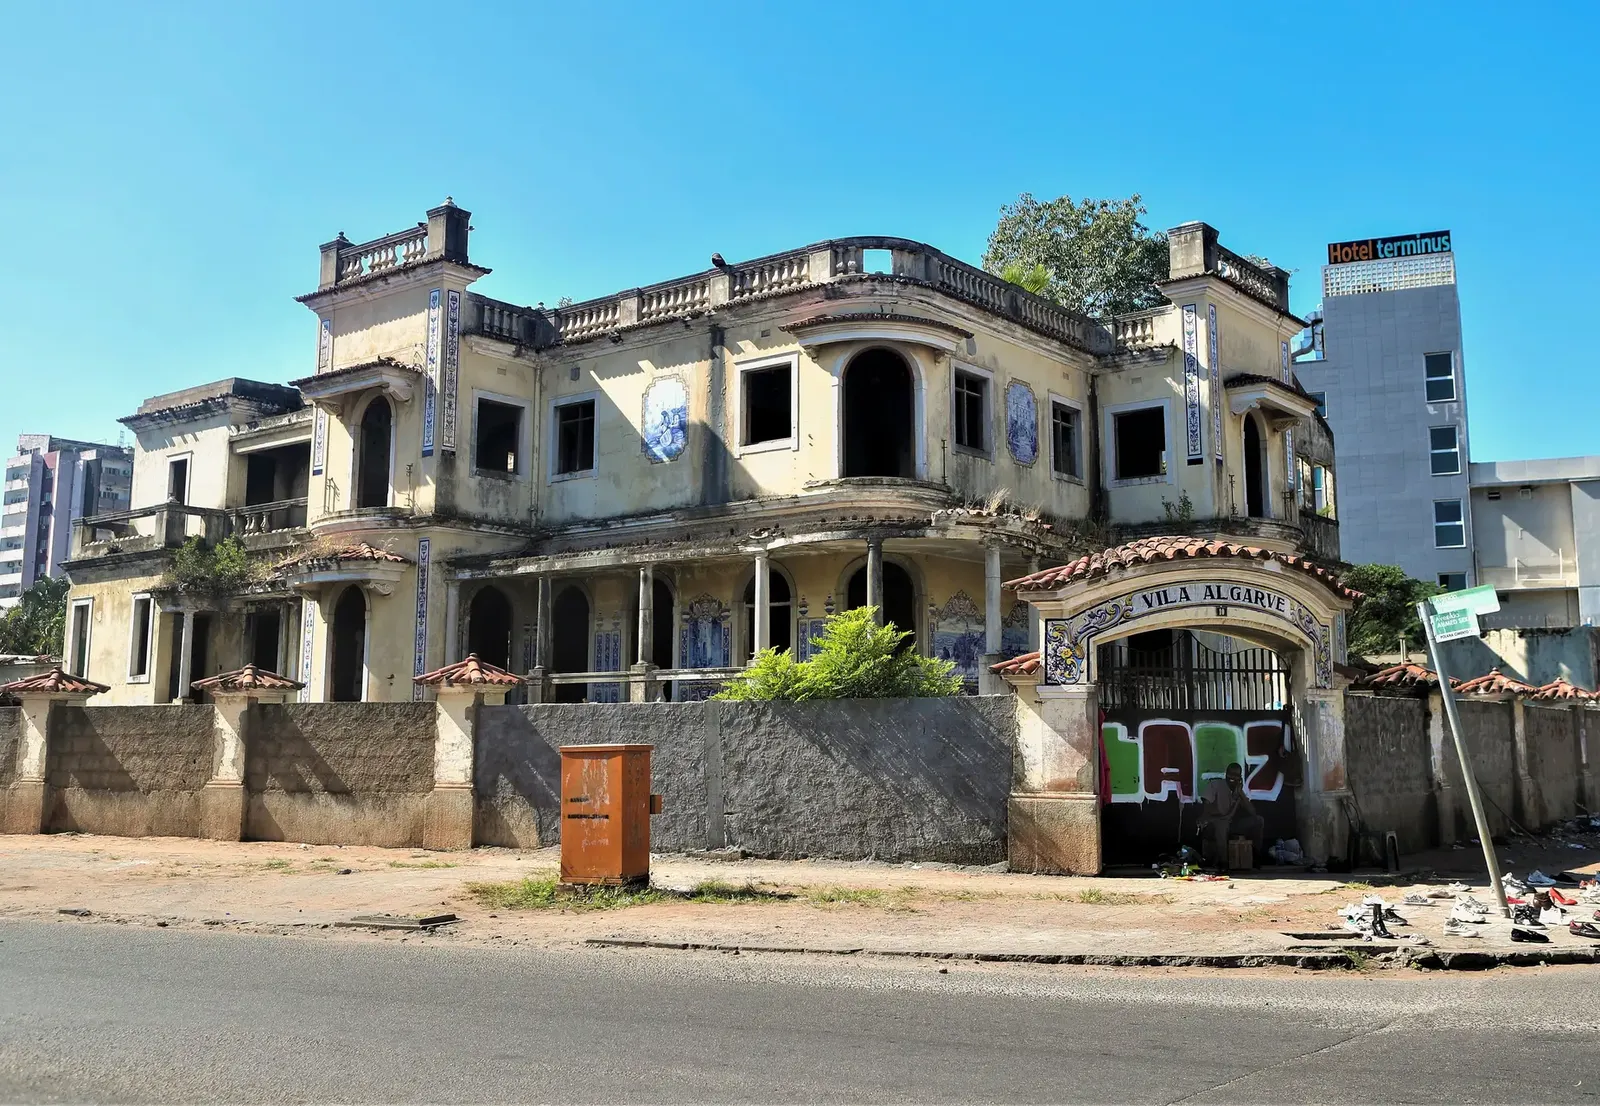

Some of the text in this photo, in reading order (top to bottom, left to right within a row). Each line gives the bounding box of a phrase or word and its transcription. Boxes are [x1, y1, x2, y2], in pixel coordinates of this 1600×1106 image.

[1329, 234, 1450, 263] Hotel terminus
[1142, 585, 1286, 613] VILA ALGARVE
